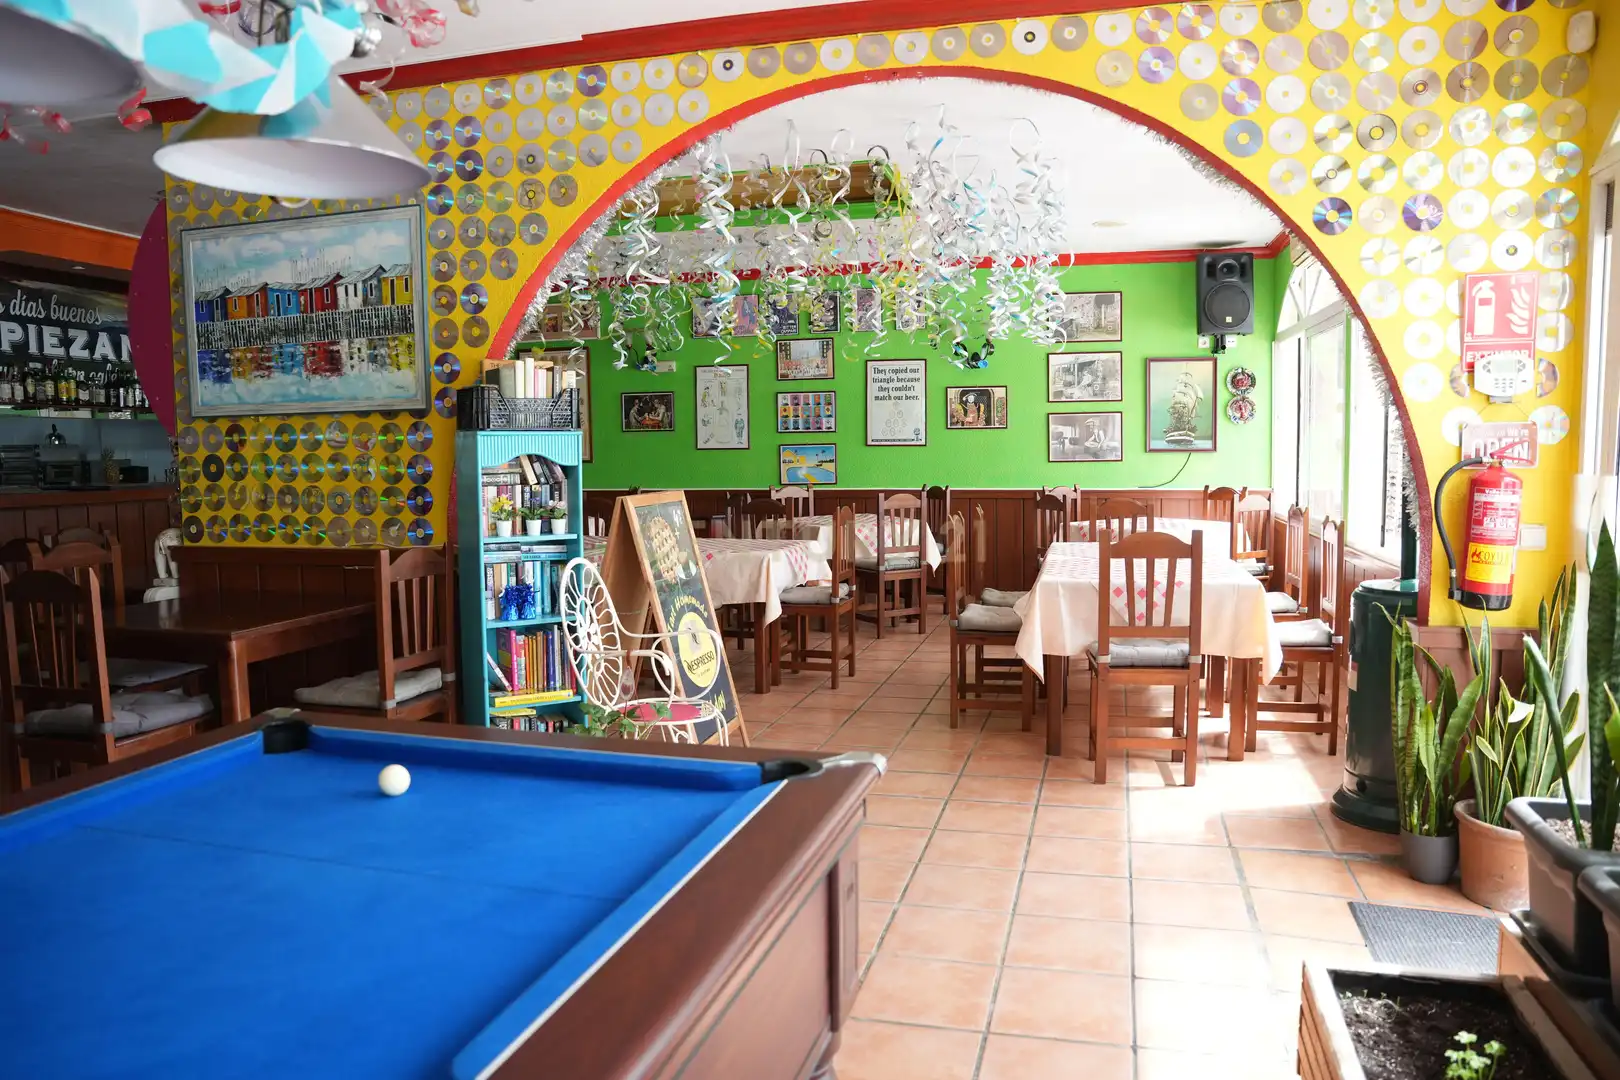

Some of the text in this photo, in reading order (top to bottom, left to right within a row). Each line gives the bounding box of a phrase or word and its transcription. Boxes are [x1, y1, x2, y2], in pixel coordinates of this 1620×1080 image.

[9, 289, 102, 325] días buenos
[873, 367, 887, 375] They
[888, 366, 908, 375] copied
[877, 385, 890, 393] they
